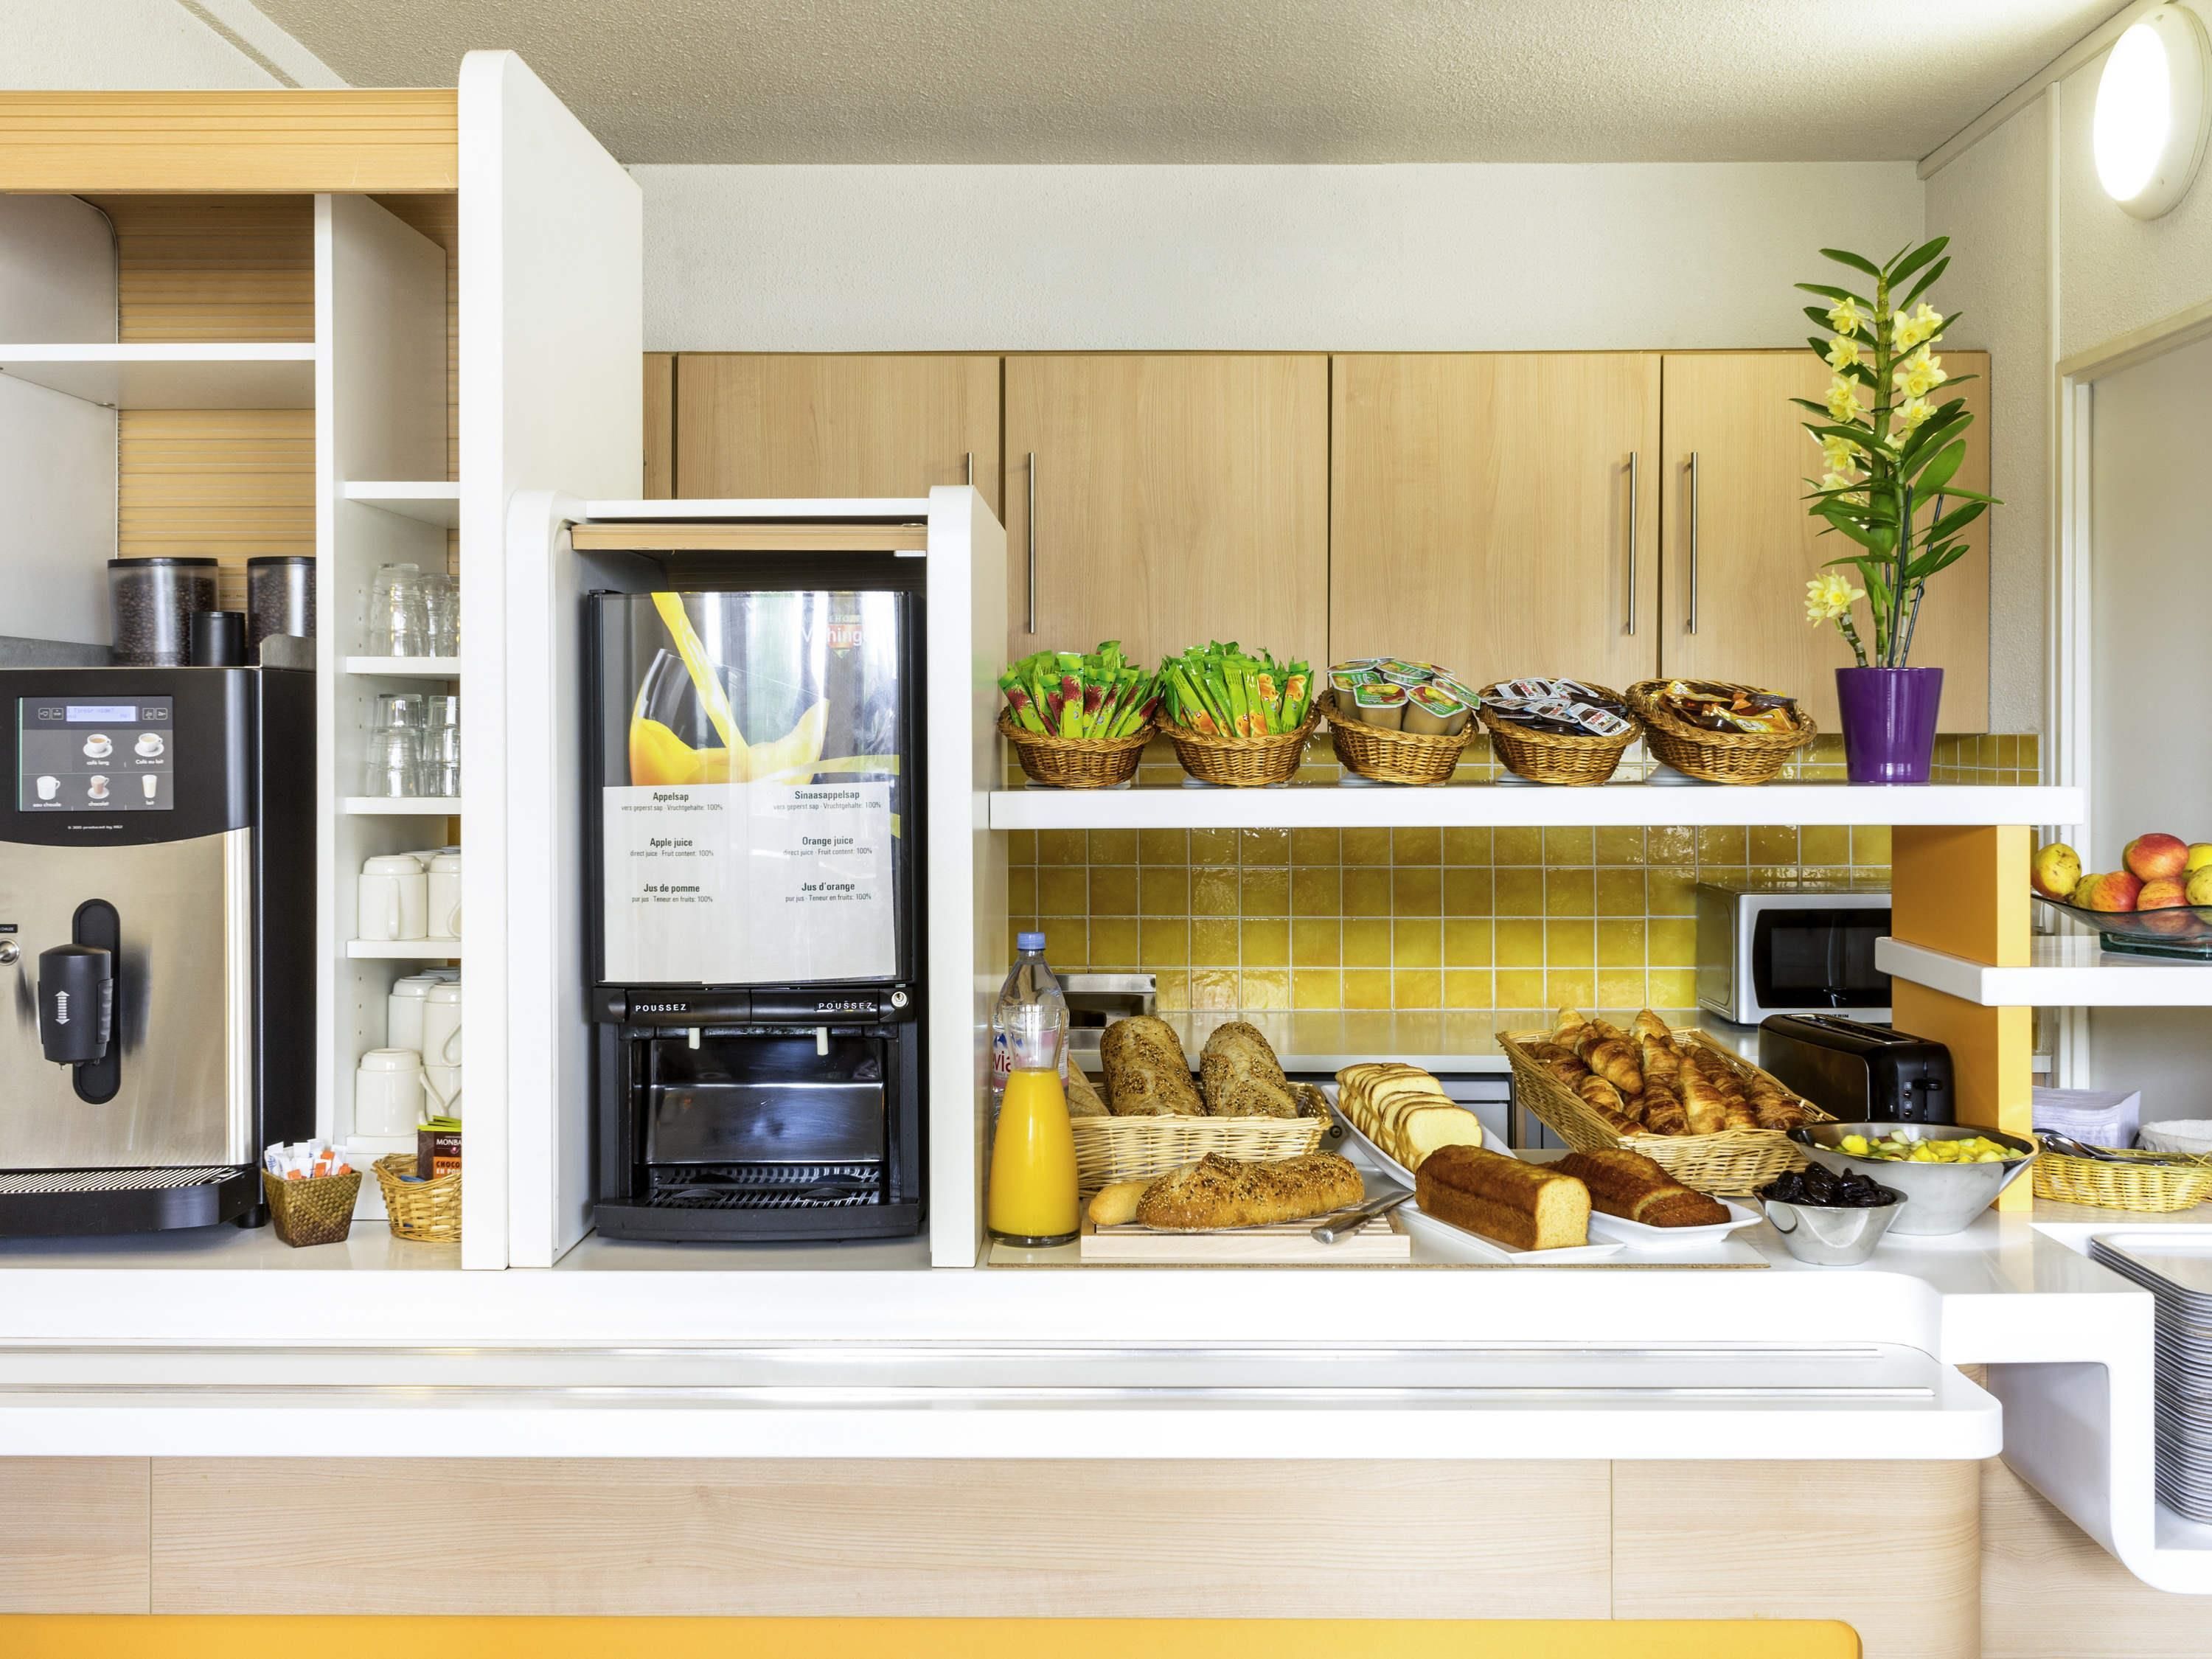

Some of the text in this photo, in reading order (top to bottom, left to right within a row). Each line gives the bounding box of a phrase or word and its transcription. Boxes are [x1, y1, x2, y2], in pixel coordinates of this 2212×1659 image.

[653, 792, 689, 802] Appelsap
[794, 790, 860, 801] Sinaasappelsap
[786, 803, 807, 811] geperst
[650, 838, 693, 849] Apple juice
[802, 835, 854, 846] Orange juice
[644, 883, 700, 894] Jus de pomme
[801, 883, 855, 891] Jus d'orange
[635, 1004, 686, 1012] POUSSEZ
[818, 1002, 872, 1010] POUSSEZ
